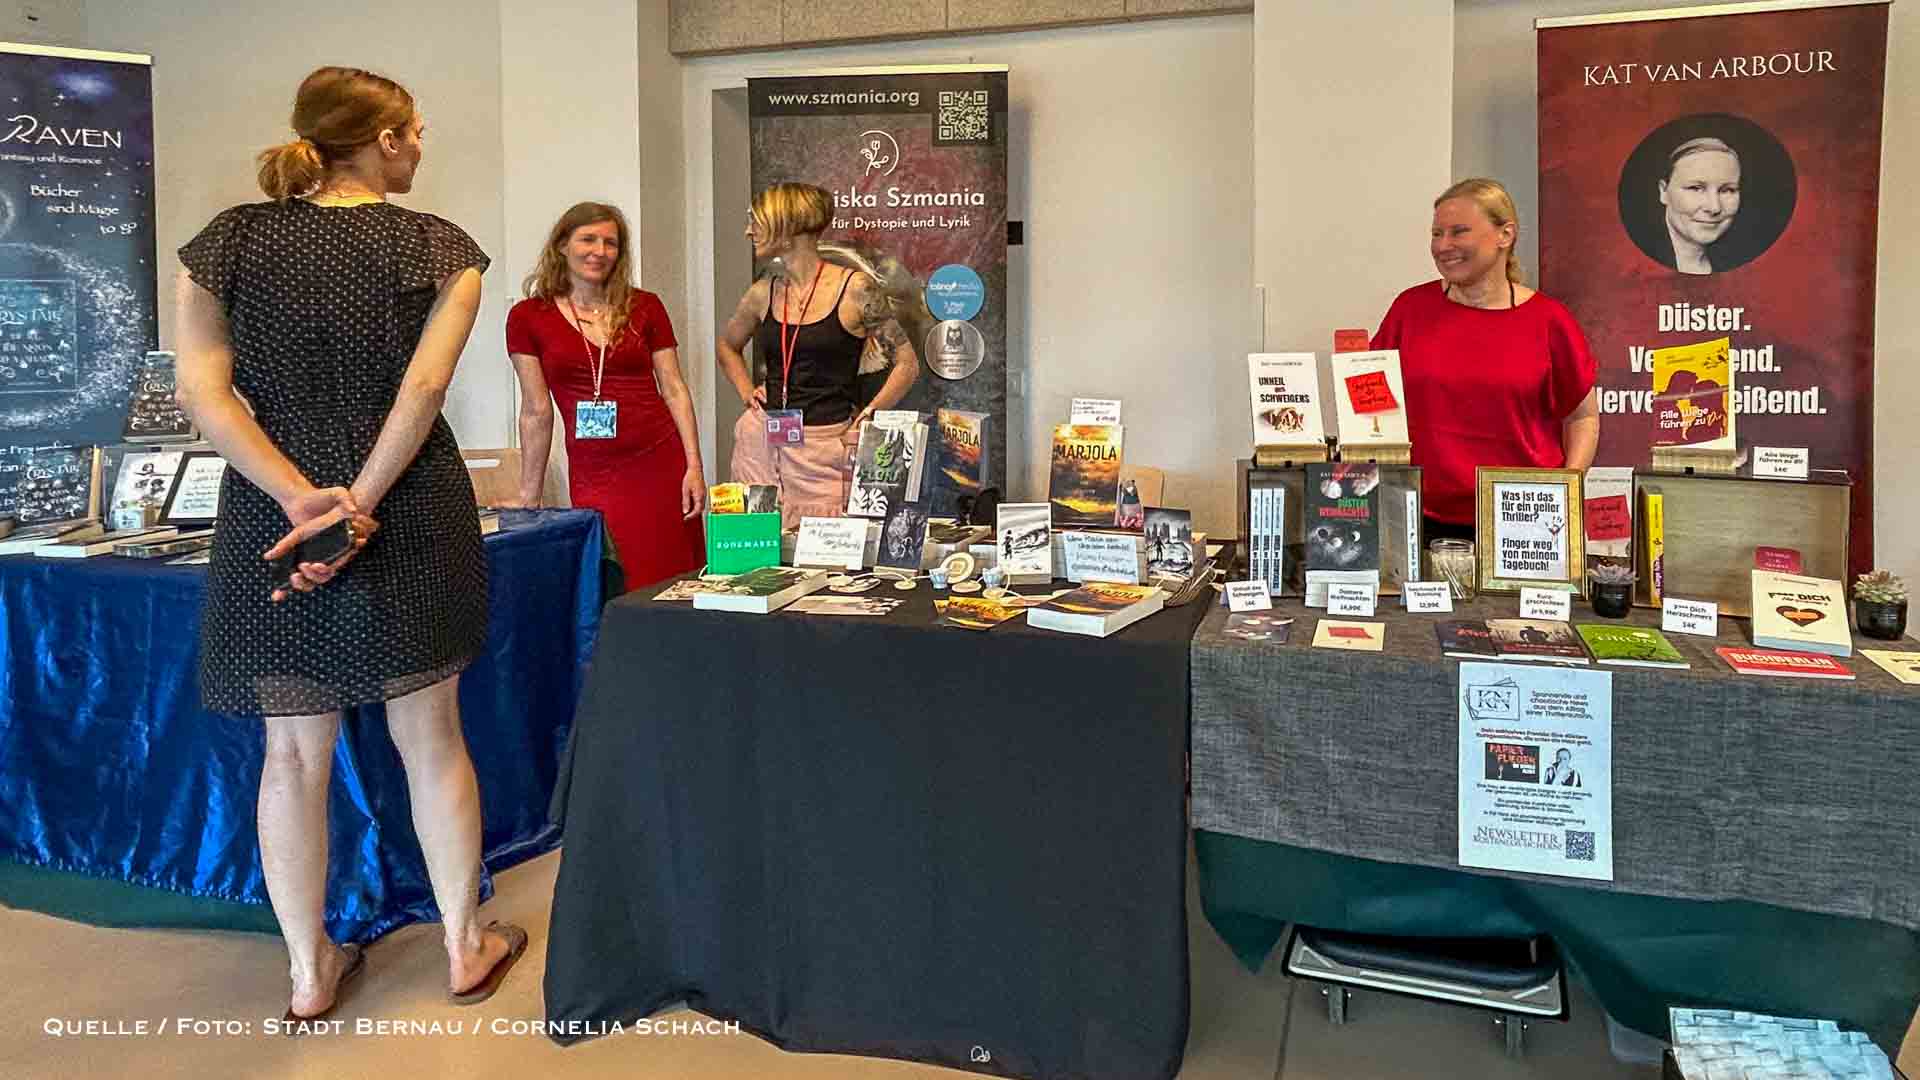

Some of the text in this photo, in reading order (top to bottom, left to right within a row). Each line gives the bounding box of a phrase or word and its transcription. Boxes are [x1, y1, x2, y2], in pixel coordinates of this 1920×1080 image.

[1583, 50, 1837, 86] KAT VAN ARBOUR
[768, 88, 920, 106] www.szmania.org
[0, 114, 122, 148] RAVEN
[36, 152, 56, 162] und
[30, 183, 83, 197] Bücher
[833, 186, 985, 208] iska Szmania
[100, 224, 116, 234] to
[832, 215, 971, 231] für Dystopie und Lyrik
[1658, 303, 1752, 331] Düster.
[1258, 376, 1286, 386] UNHEIL
[1260, 393, 1310, 404] SCHWEIGENS
[1660, 409, 1679, 419] Alle
[1660, 419, 1692, 429] führen
[1695, 416, 1706, 426] zu
[1054, 444, 1117, 461] MARJOLA
[1501, 491, 1554, 502] Was ist das
[1501, 501, 1514, 511] für
[1517, 502, 1531, 511] ein
[1502, 512, 1540, 523] Thriller?
[716, 540, 778, 549] BOOKMARKS
[1502, 538, 1553, 551] Finger weg
[1502, 549, 1559, 561] von meinem
[1502, 560, 1550, 571] Tagebuch!
[1797, 594, 1831, 602] DICH
[1477, 825, 1558, 843] NEWSLETTER
